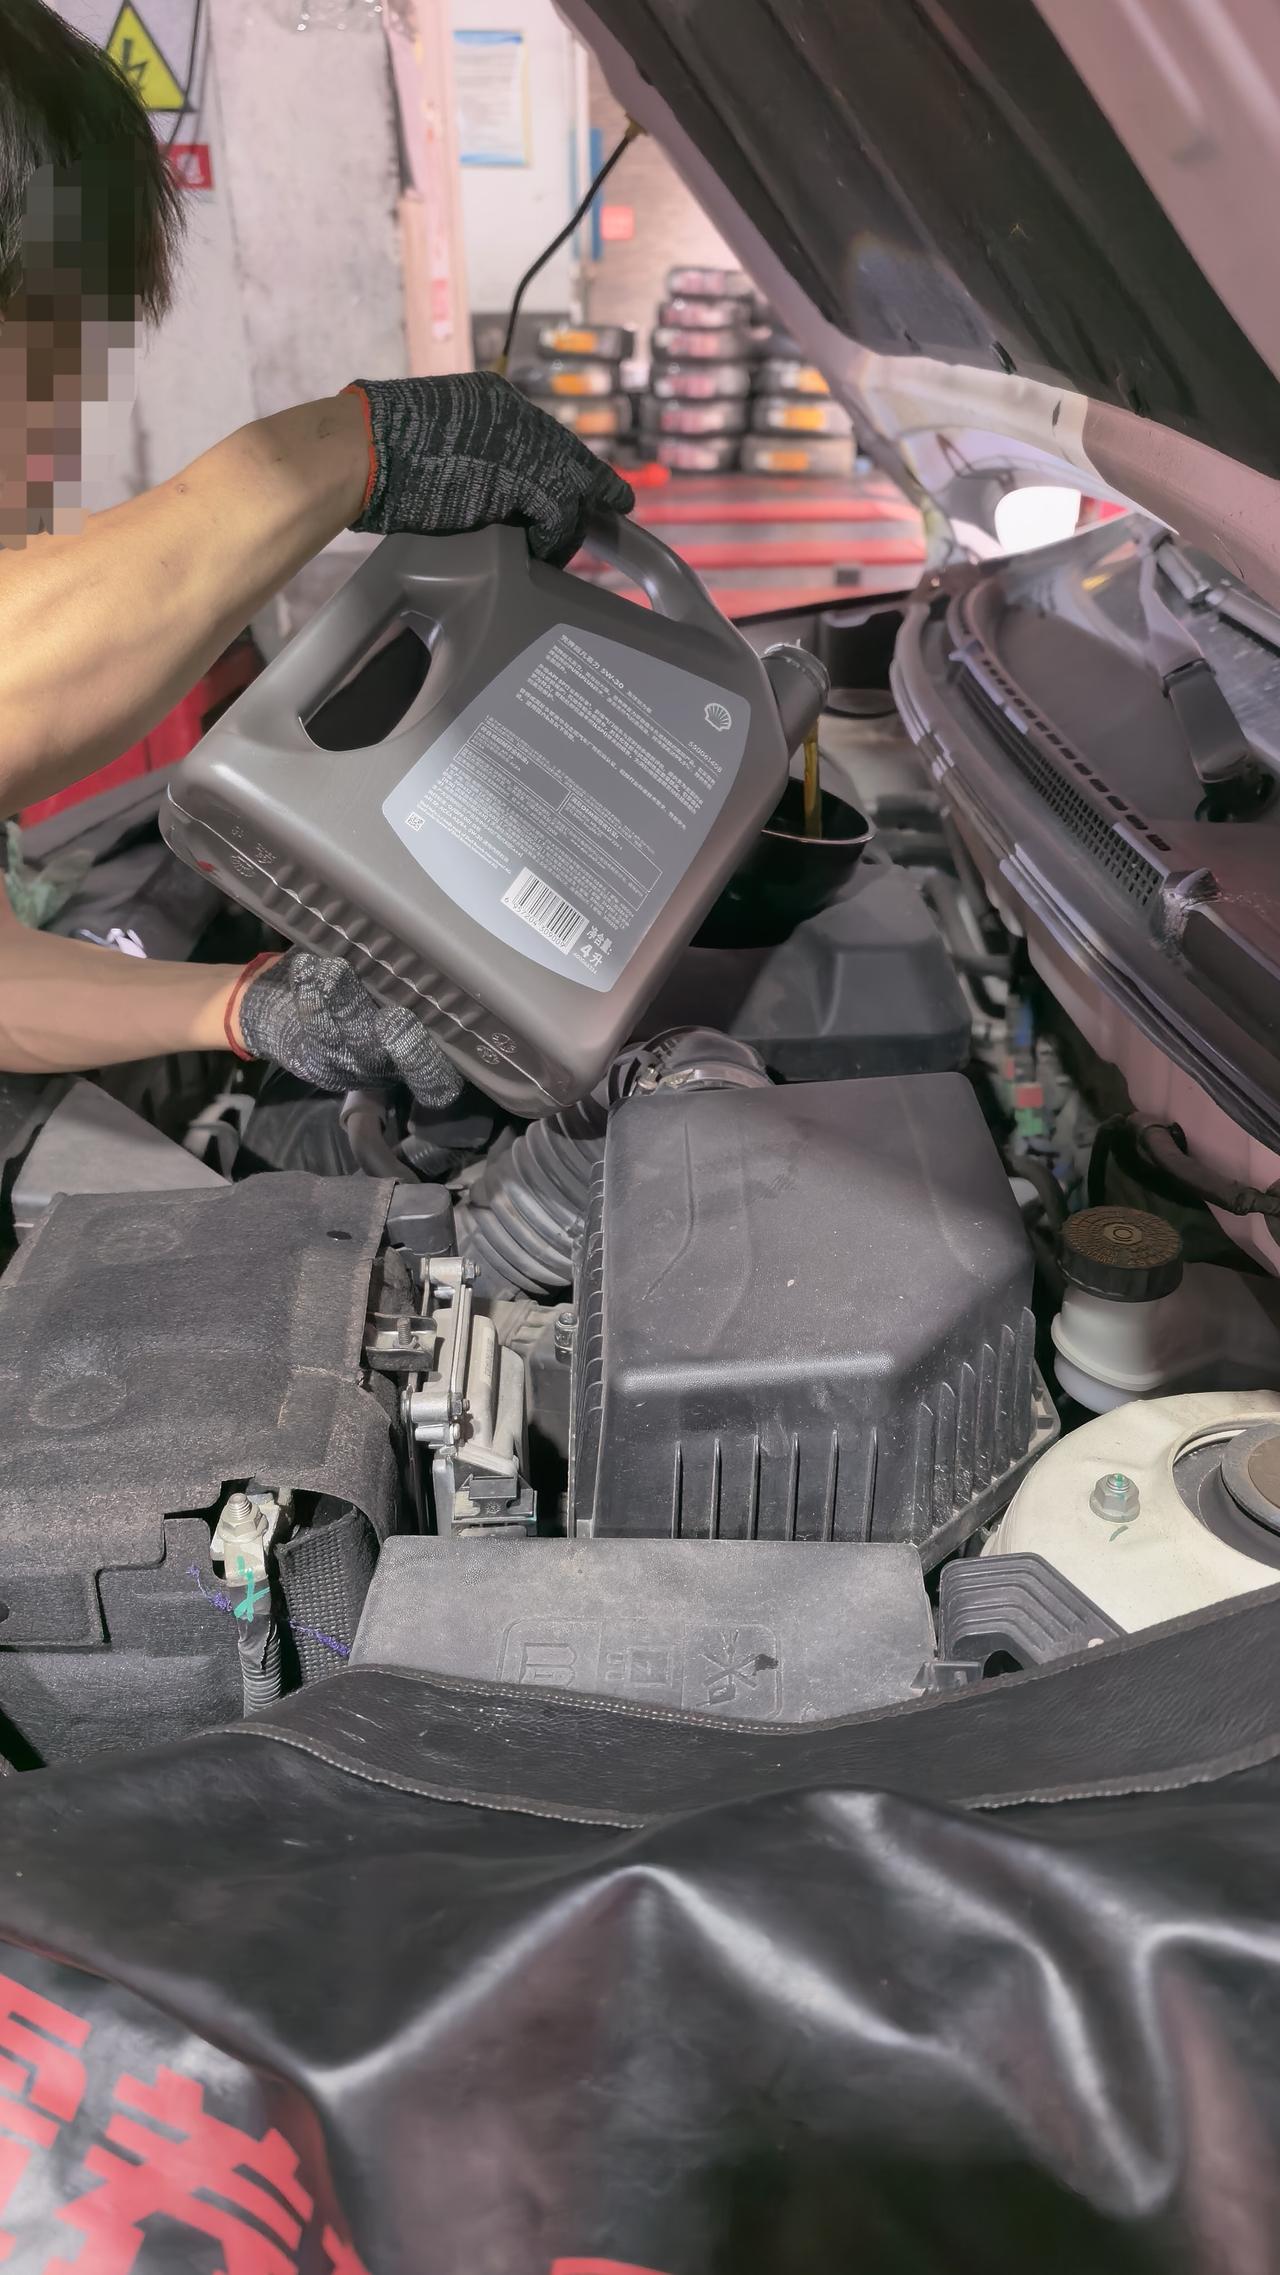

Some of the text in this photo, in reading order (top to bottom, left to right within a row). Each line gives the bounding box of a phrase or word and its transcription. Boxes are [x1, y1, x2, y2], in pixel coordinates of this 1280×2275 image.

[599, 667, 624, 689] 5W-30
[512, 903, 538, 926] 957204
[539, 925, 566, 948] 309009
